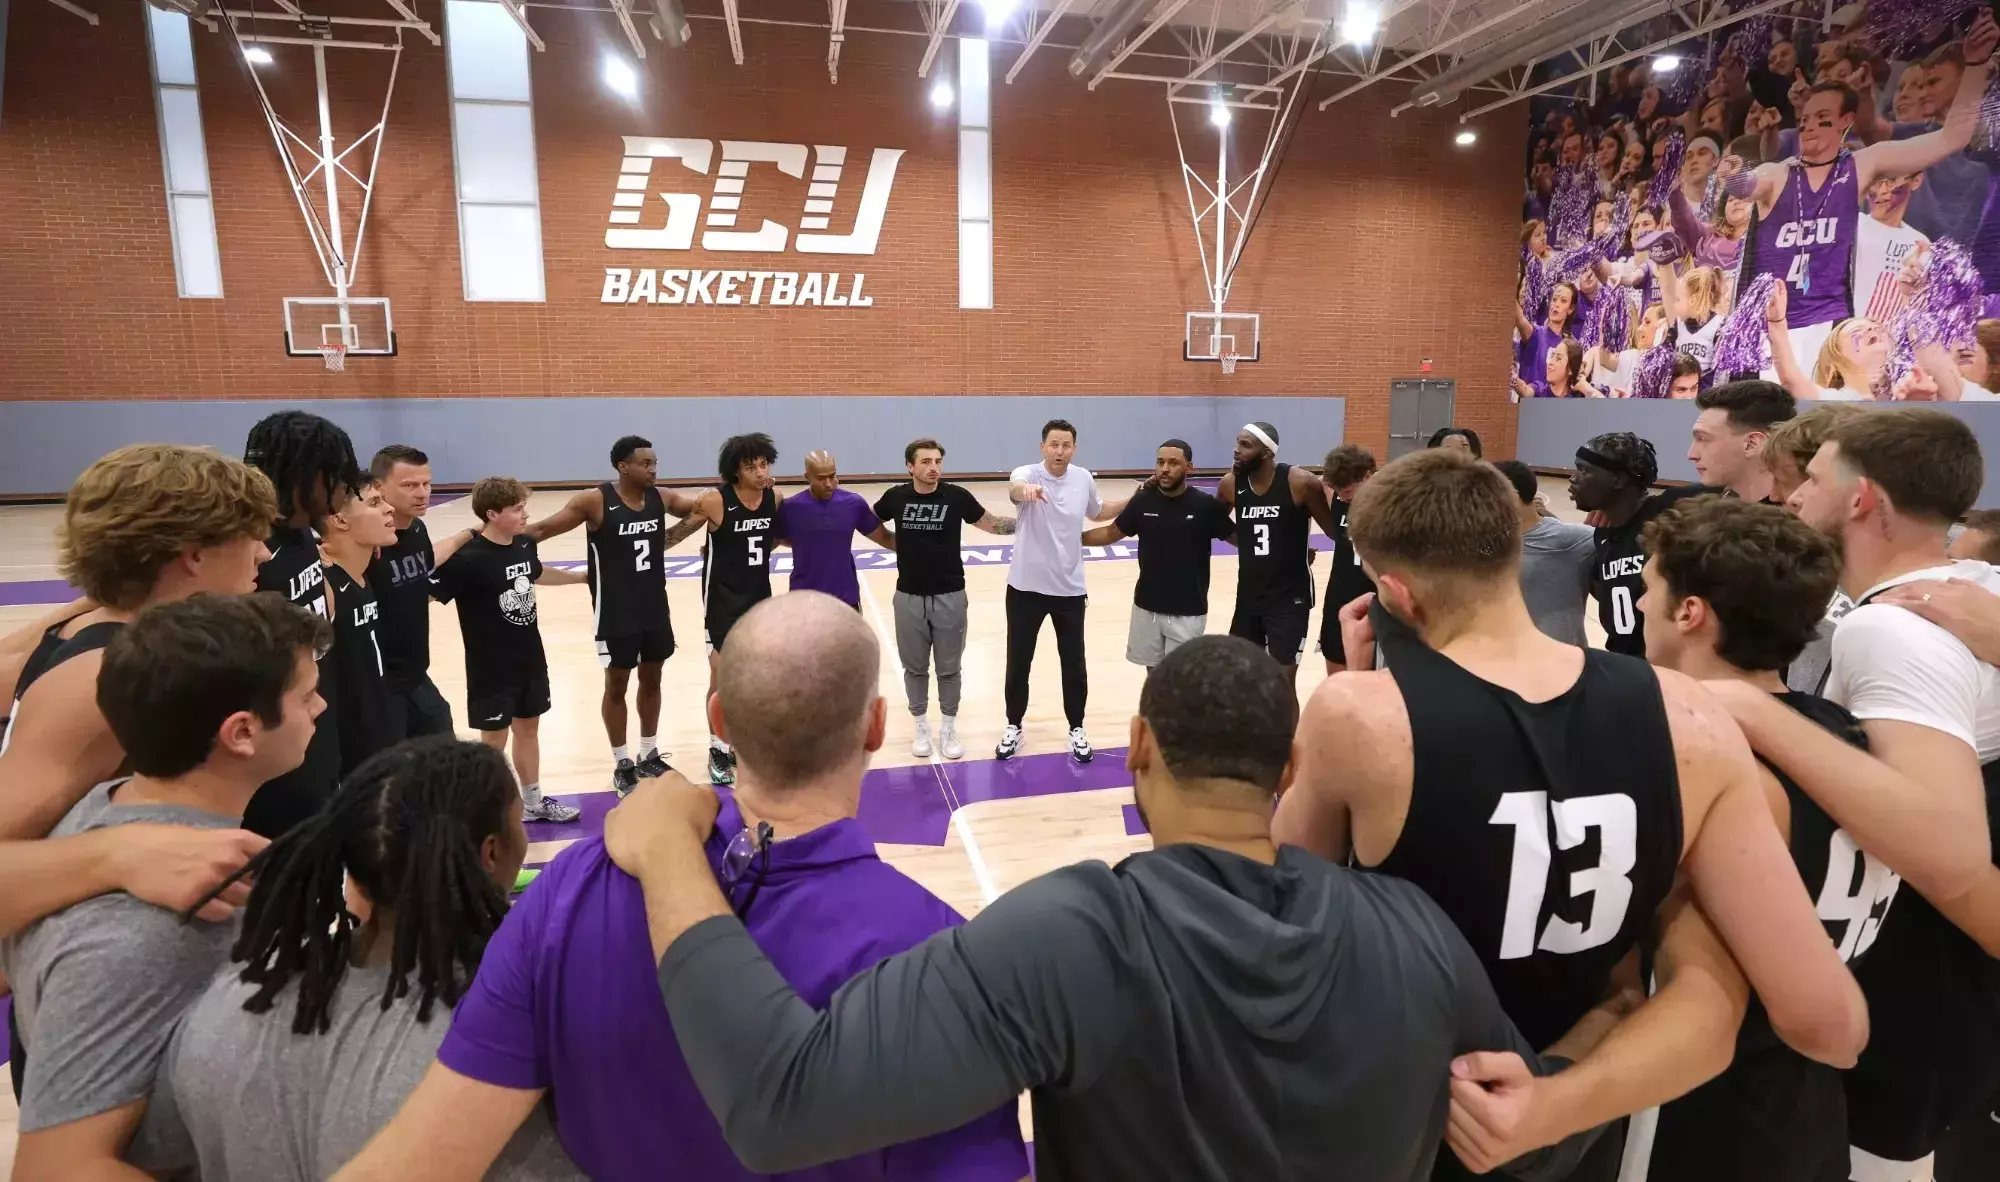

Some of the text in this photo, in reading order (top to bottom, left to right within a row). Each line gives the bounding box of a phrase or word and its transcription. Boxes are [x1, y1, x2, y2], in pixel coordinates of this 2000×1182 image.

[604, 136, 907, 255] GCU
[1776, 217, 1838, 248] GCU
[600, 268, 874, 307] BASKETBALL
[618, 518, 659, 536] LOPES
[734, 517, 772, 533] LOPES
[901, 522, 944, 531] BASKETBALL
[902, 503, 949, 522] GCU
[1241, 505, 1281, 519] LOPES
[633, 539, 651, 572] 2
[747, 535, 763, 567] 5
[1253, 523, 1271, 556] 3
[289, 558, 323, 601] LOPES
[505, 560, 532, 581] GCU
[1611, 586, 1636, 635] 0
[370, 630, 384, 677] 1
[1487, 789, 1638, 960] 13
